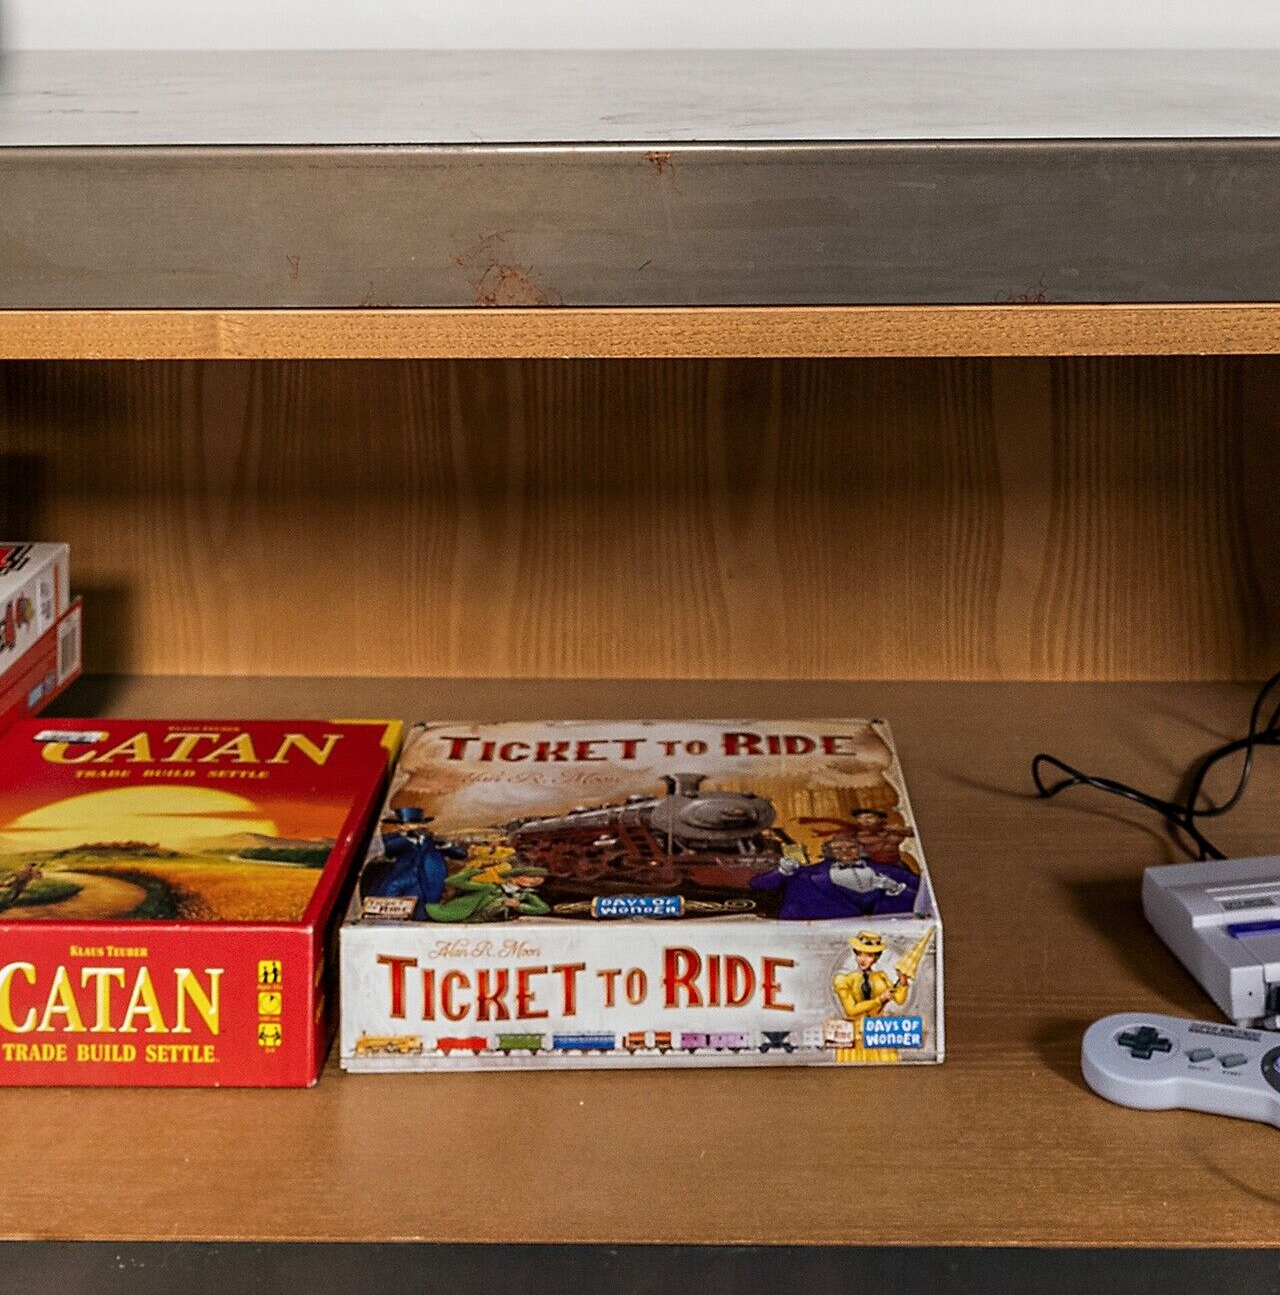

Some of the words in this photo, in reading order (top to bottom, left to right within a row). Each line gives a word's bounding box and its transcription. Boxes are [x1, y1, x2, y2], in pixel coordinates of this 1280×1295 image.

[40, 732, 345, 765] CATAN
[440, 736, 647, 762] TICKET
[657, 740, 709, 756] TO
[722, 732, 858, 756] RIDE
[74, 769, 132, 779] TRADE
[142, 769, 197, 779] BUILD
[206, 769, 271, 780] SETTLE
[600, 897, 648, 906] DAYS
[650, 897, 672, 906] OF
[69, 944, 105, 957] KLAUS
[106, 945, 148, 958] TEUBER
[427, 938, 468, 960] Alan
[470, 940, 495, 958] R.
[498, 938, 542, 958] Moon
[376, 953, 587, 1022] TICKET
[596, 967, 649, 1008] TO
[662, 945, 796, 1013] RIDE
[865, 1019, 899, 1033] DAYS
[901, 1018, 920, 1032] OF
[2, 1043, 68, 1062] TRADE
[76, 1043, 137, 1063] BUILD
[145, 1043, 216, 1064] SETTLE
